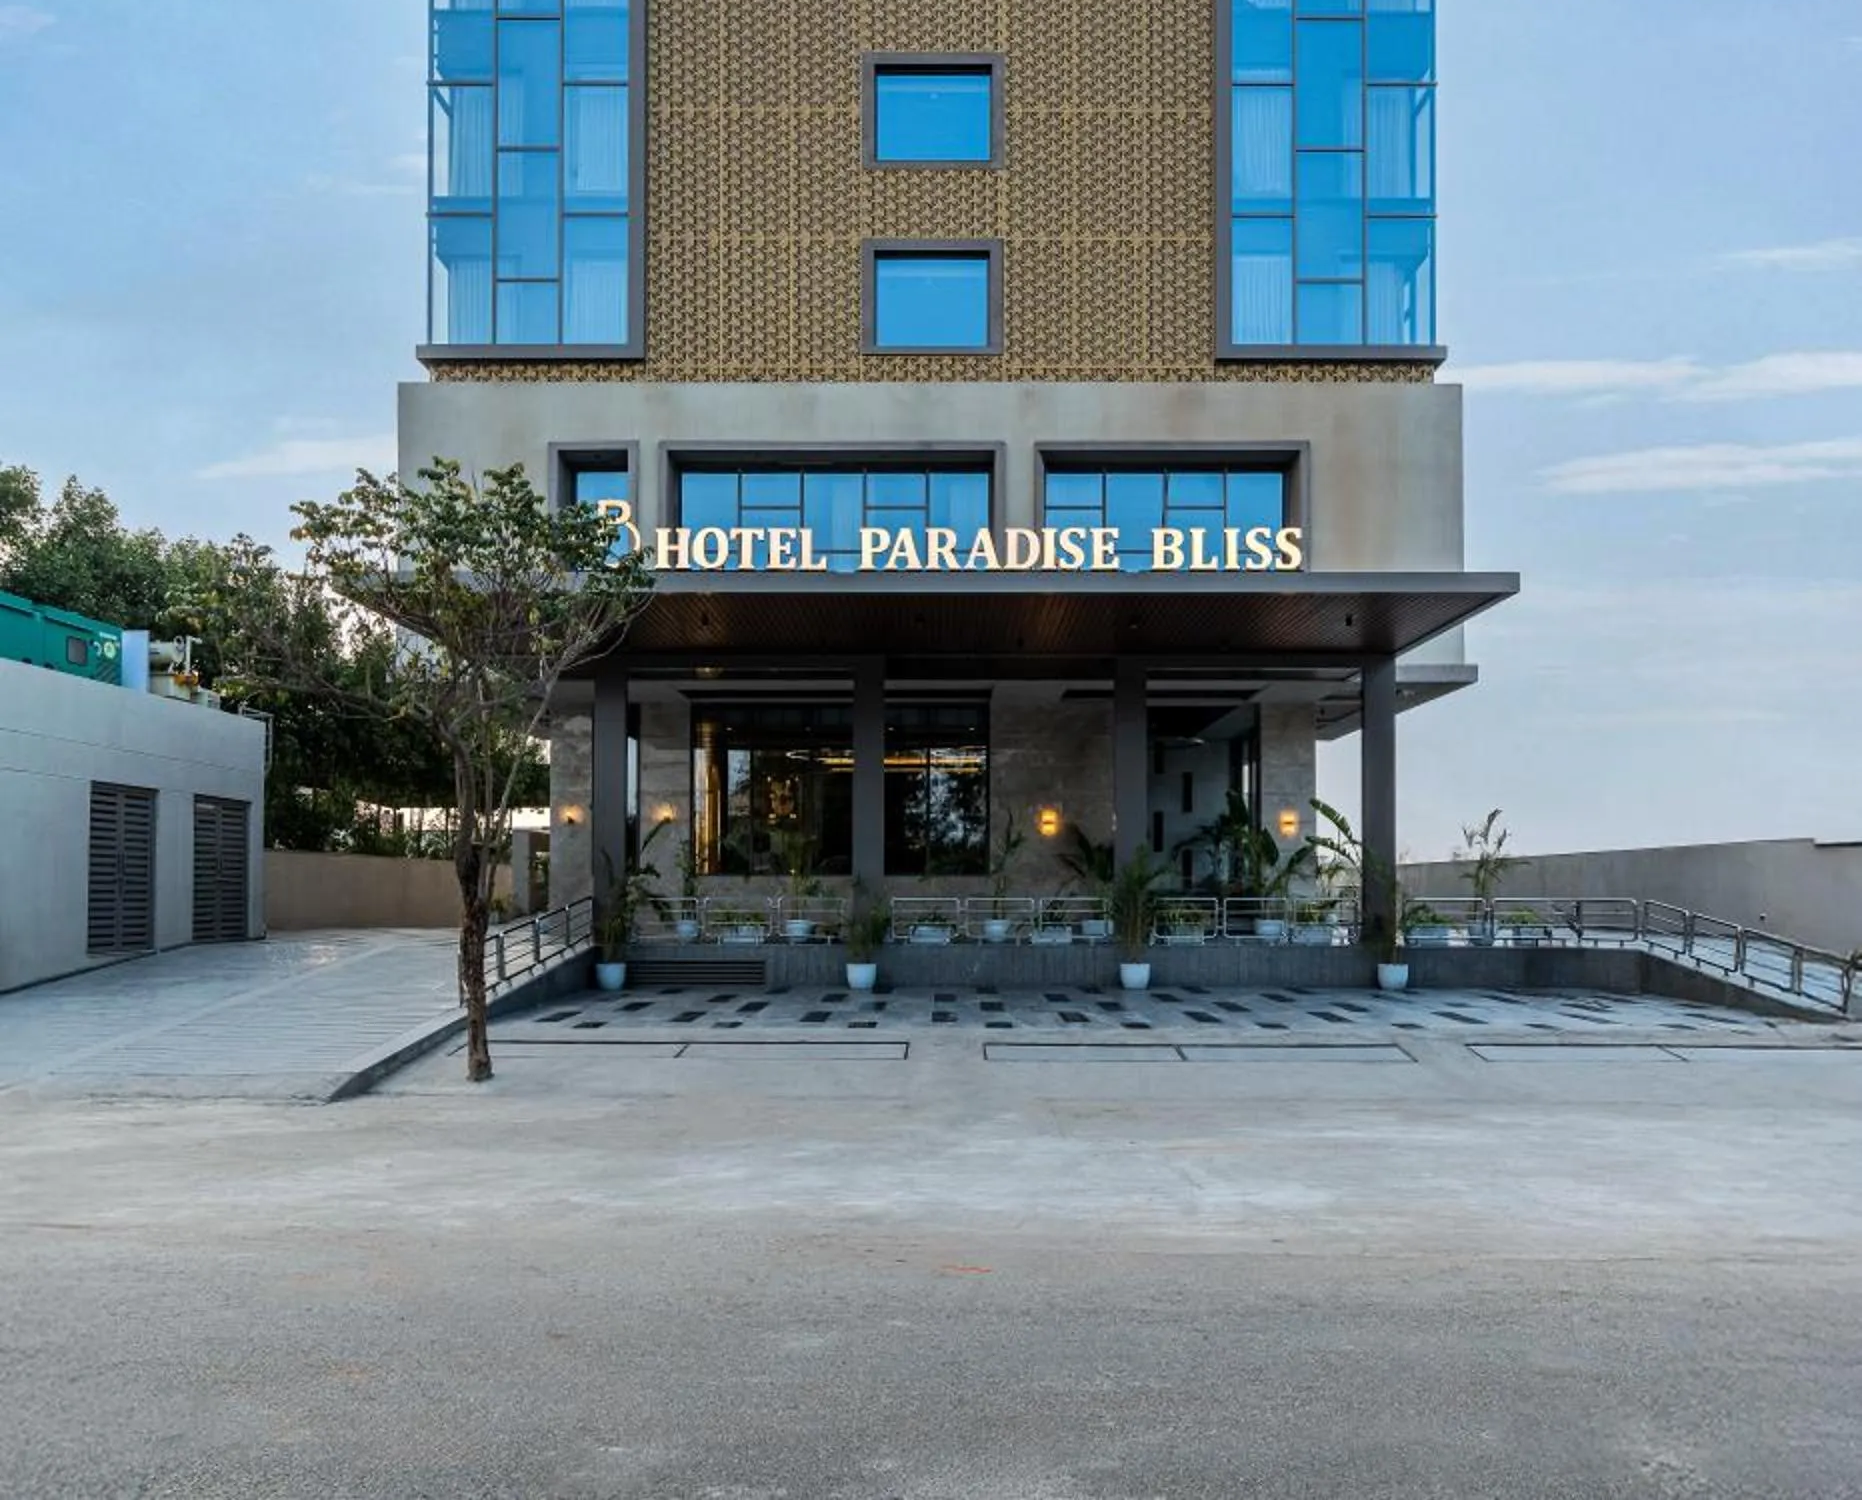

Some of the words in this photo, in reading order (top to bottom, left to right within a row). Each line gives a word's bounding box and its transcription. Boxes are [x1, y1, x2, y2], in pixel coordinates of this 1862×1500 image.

[654, 527, 827, 570] HOTEL
[859, 527, 1119, 570] PARADISE
[1152, 527, 1303, 570] BLISS
